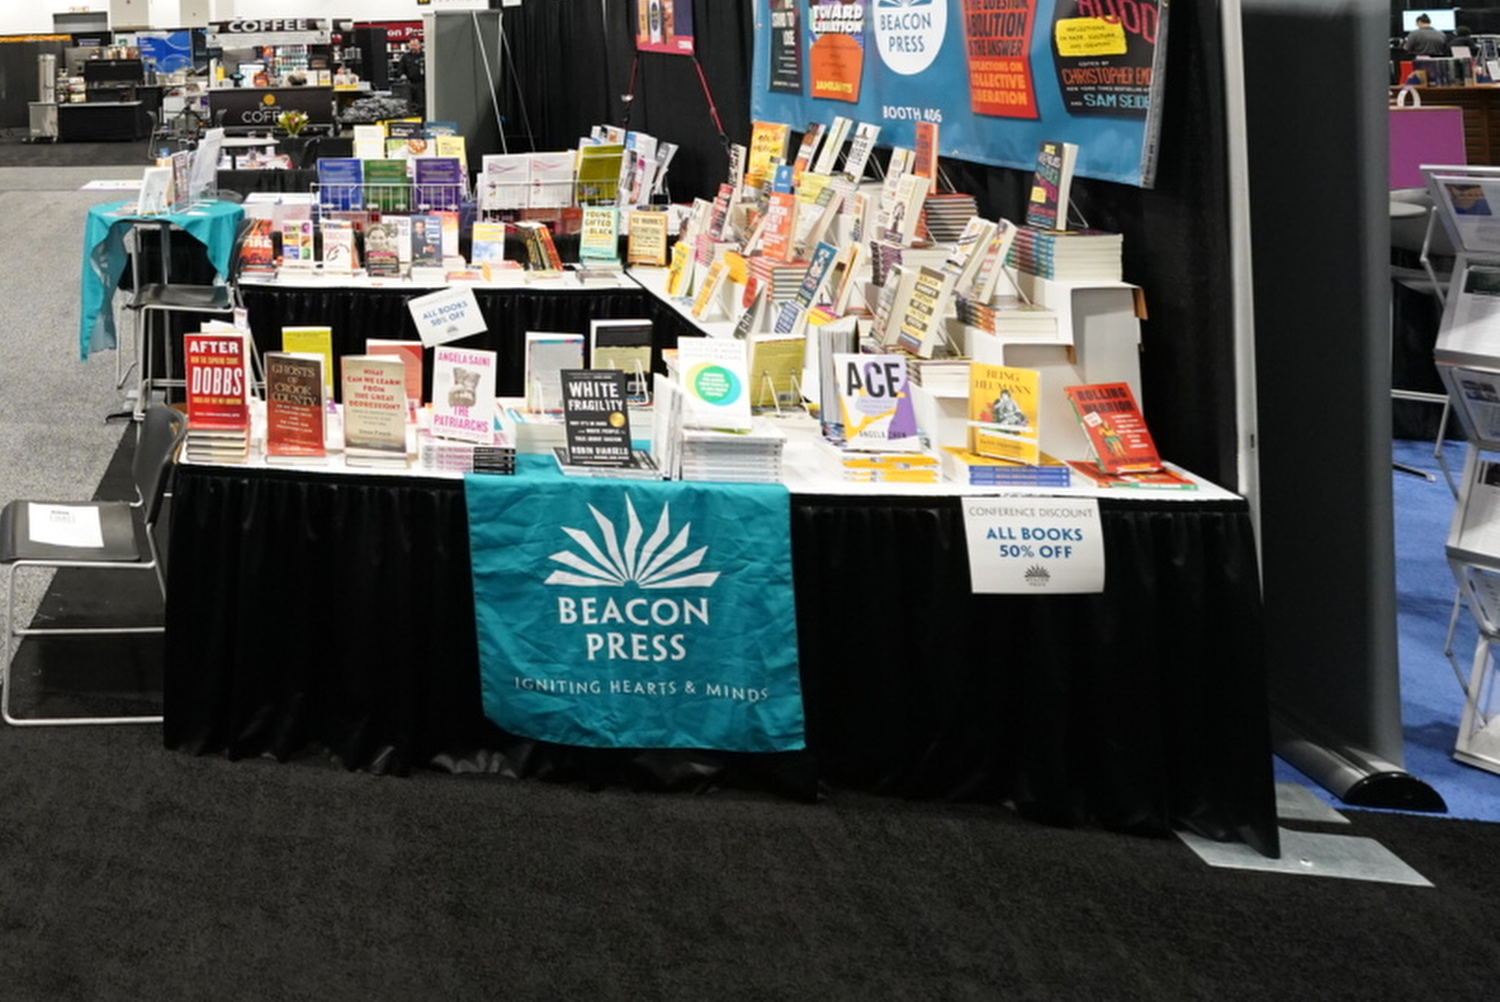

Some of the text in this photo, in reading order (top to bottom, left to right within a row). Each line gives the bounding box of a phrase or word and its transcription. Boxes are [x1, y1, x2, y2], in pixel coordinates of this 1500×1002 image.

[227, 19, 308, 32] COFFEE
[880, 12, 932, 31] BEACON
[888, 35, 926, 53] PRESS
[1062, 67, 1134, 85] CHRISTOPHER
[1083, 93, 1117, 108] SAM
[241, 109, 281, 124] COFF
[882, 105, 943, 123] BOOTH 406
[584, 218, 612, 227] GIFTED
[423, 300, 468, 319] ALL BOOKS
[449, 310, 466, 321] OFF
[189, 341, 239, 354] AFTER
[438, 352, 491, 367] ANGELA SAINI
[271, 364, 315, 378] GHOSTS
[987, 369, 1020, 382] BEING
[192, 366, 243, 396] DOBBS
[376, 378, 401, 386] LEARN
[847, 362, 905, 398] ACE
[274, 382, 312, 396] CROOK
[363, 385, 385, 393] FROM
[569, 381, 619, 398] WHITE
[1076, 387, 1127, 401] ROLLING
[271, 392, 317, 407] COUNTY
[370, 393, 395, 401] GREAT
[452, 404, 470, 417] THE
[568, 399, 623, 412] FRAGILITY
[434, 414, 489, 433] PATRIARCHS
[859, 430, 886, 438] ANGELA
[571, 446, 594, 455] ROBIN
[968, 505, 1094, 519] CONFERENCE DISCOUNT
[986, 527, 1083, 542] ALL BOOKS
[999, 545, 1073, 559] 50% OFF
[557, 597, 710, 626] BEACON
[585, 632, 687, 662] PRESS
[513, 676, 770, 703] IGNITING HEARTS & MINDS
